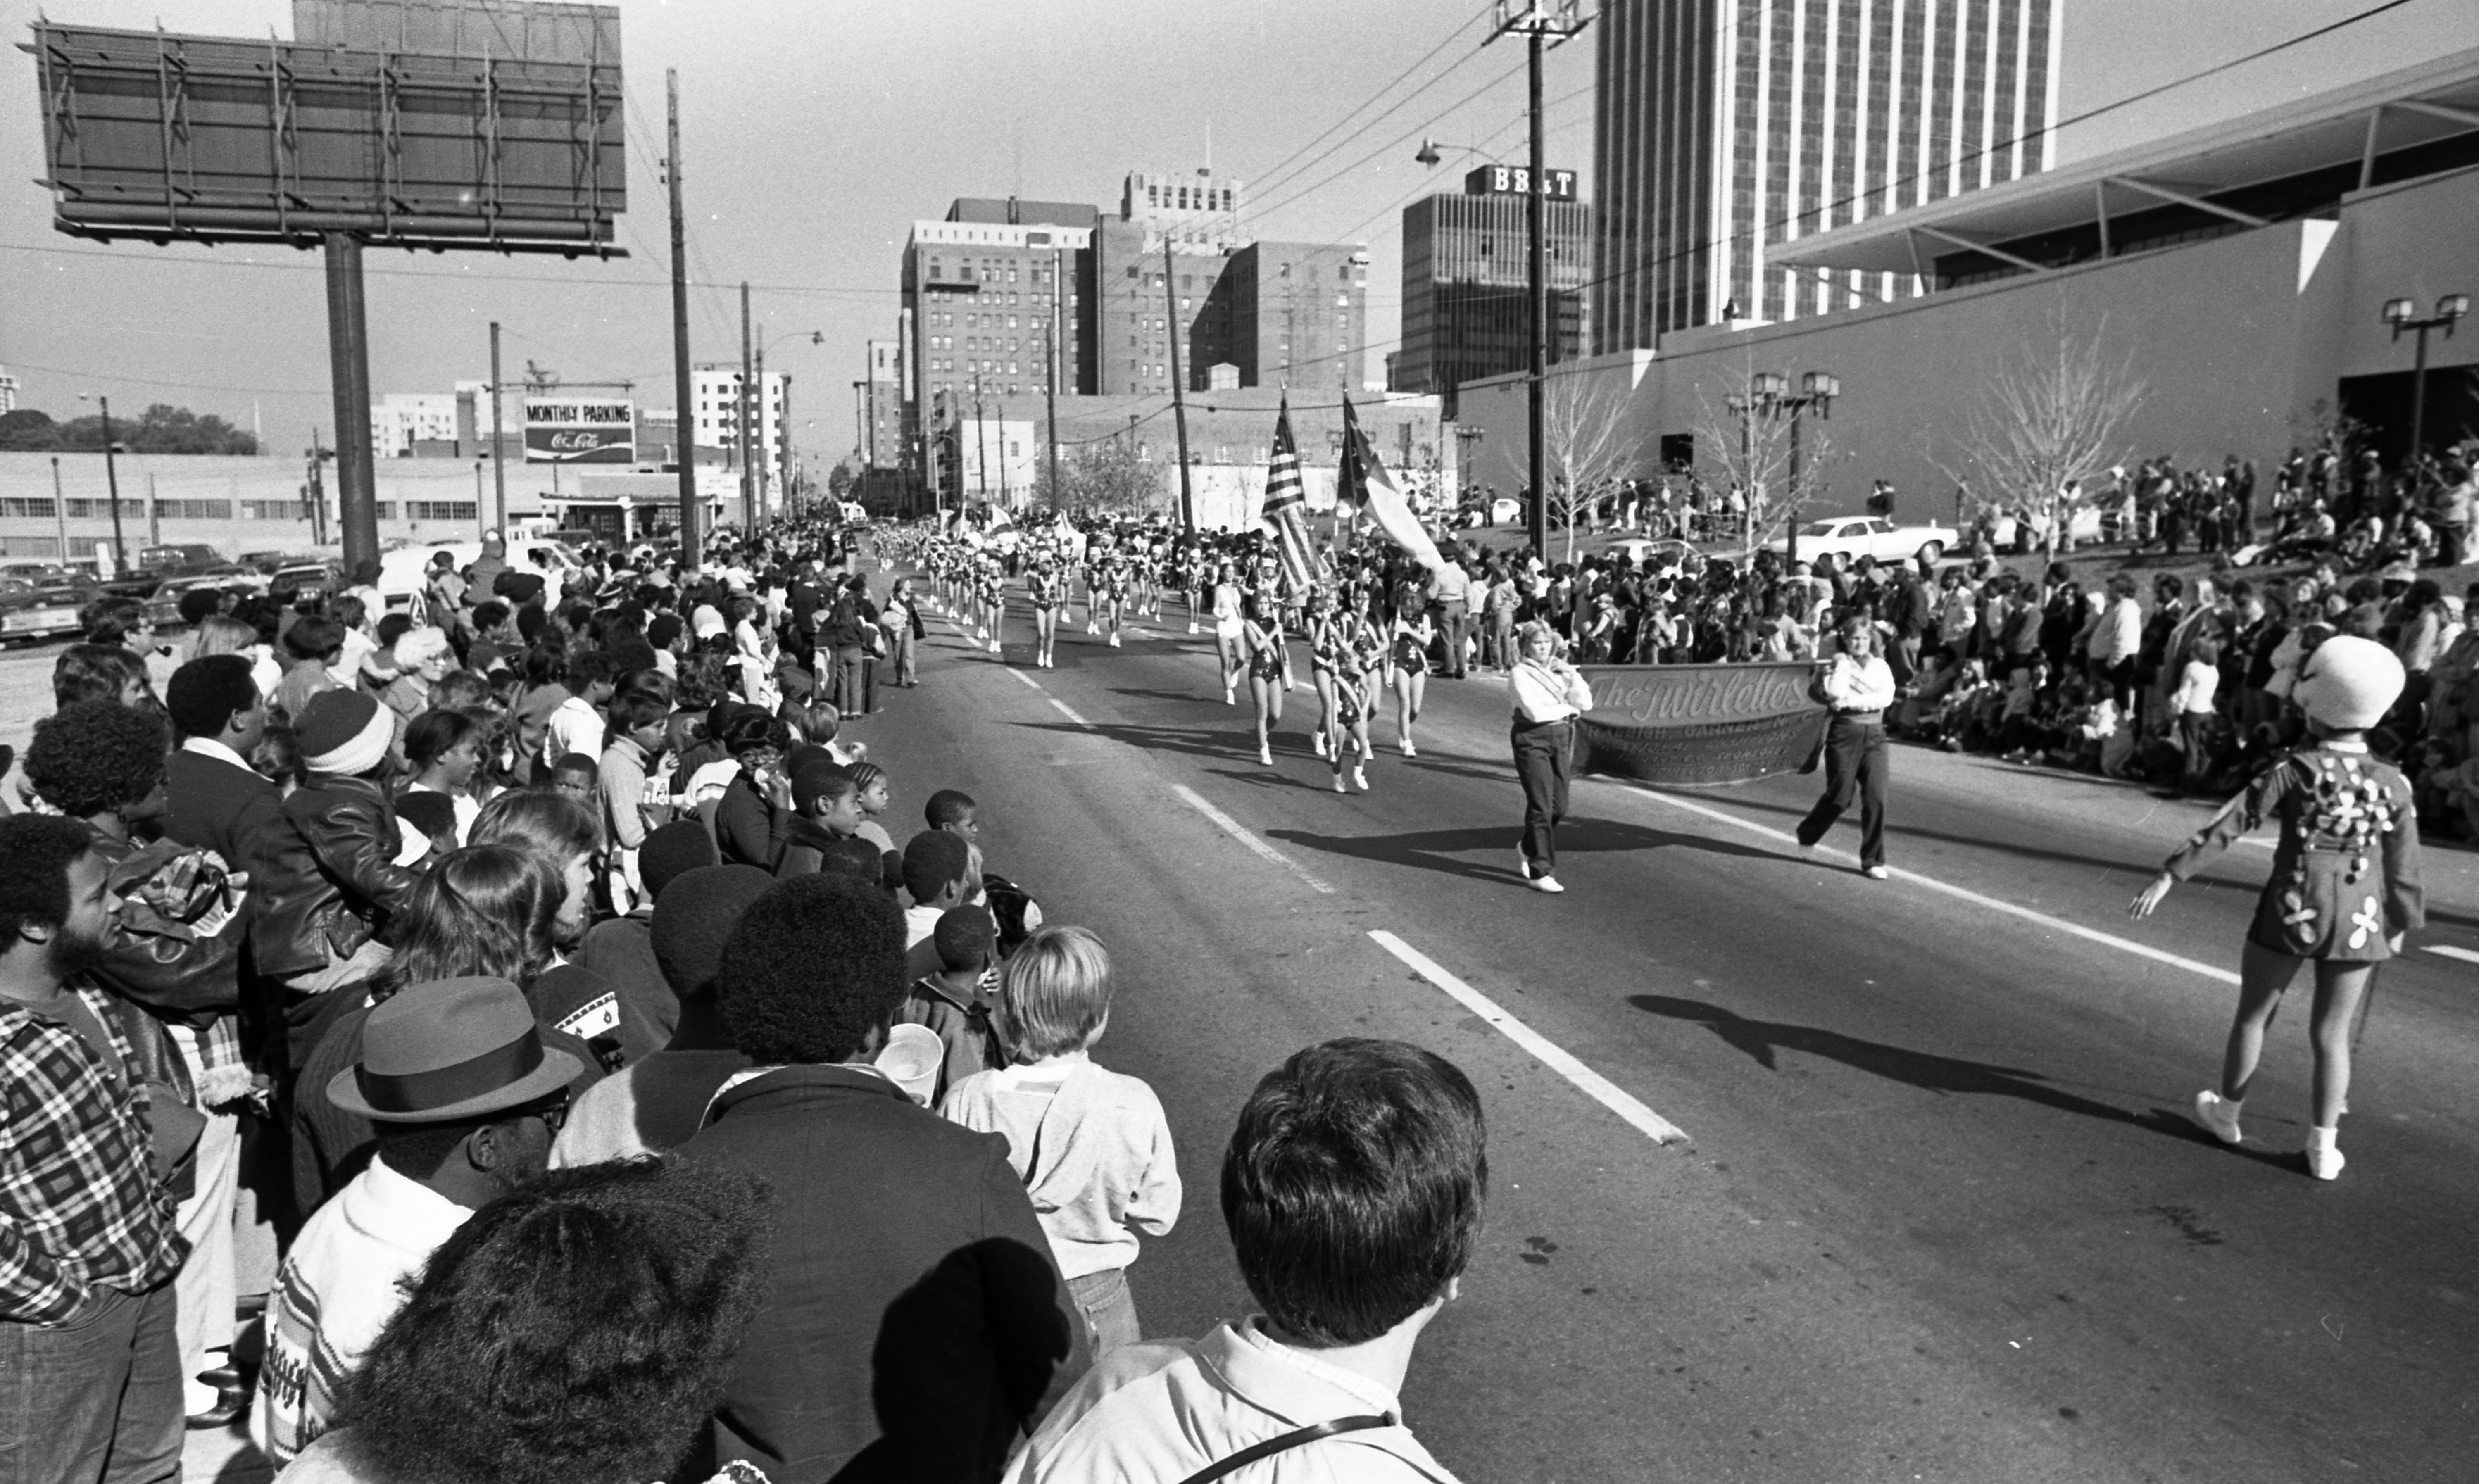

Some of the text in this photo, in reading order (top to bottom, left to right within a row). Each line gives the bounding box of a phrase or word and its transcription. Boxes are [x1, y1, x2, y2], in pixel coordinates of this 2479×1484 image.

[527, 405, 630, 422] MONTHLY PARKING
[1590, 676, 1641, 707] The
[1630, 668, 1806, 721] Twirlettes
